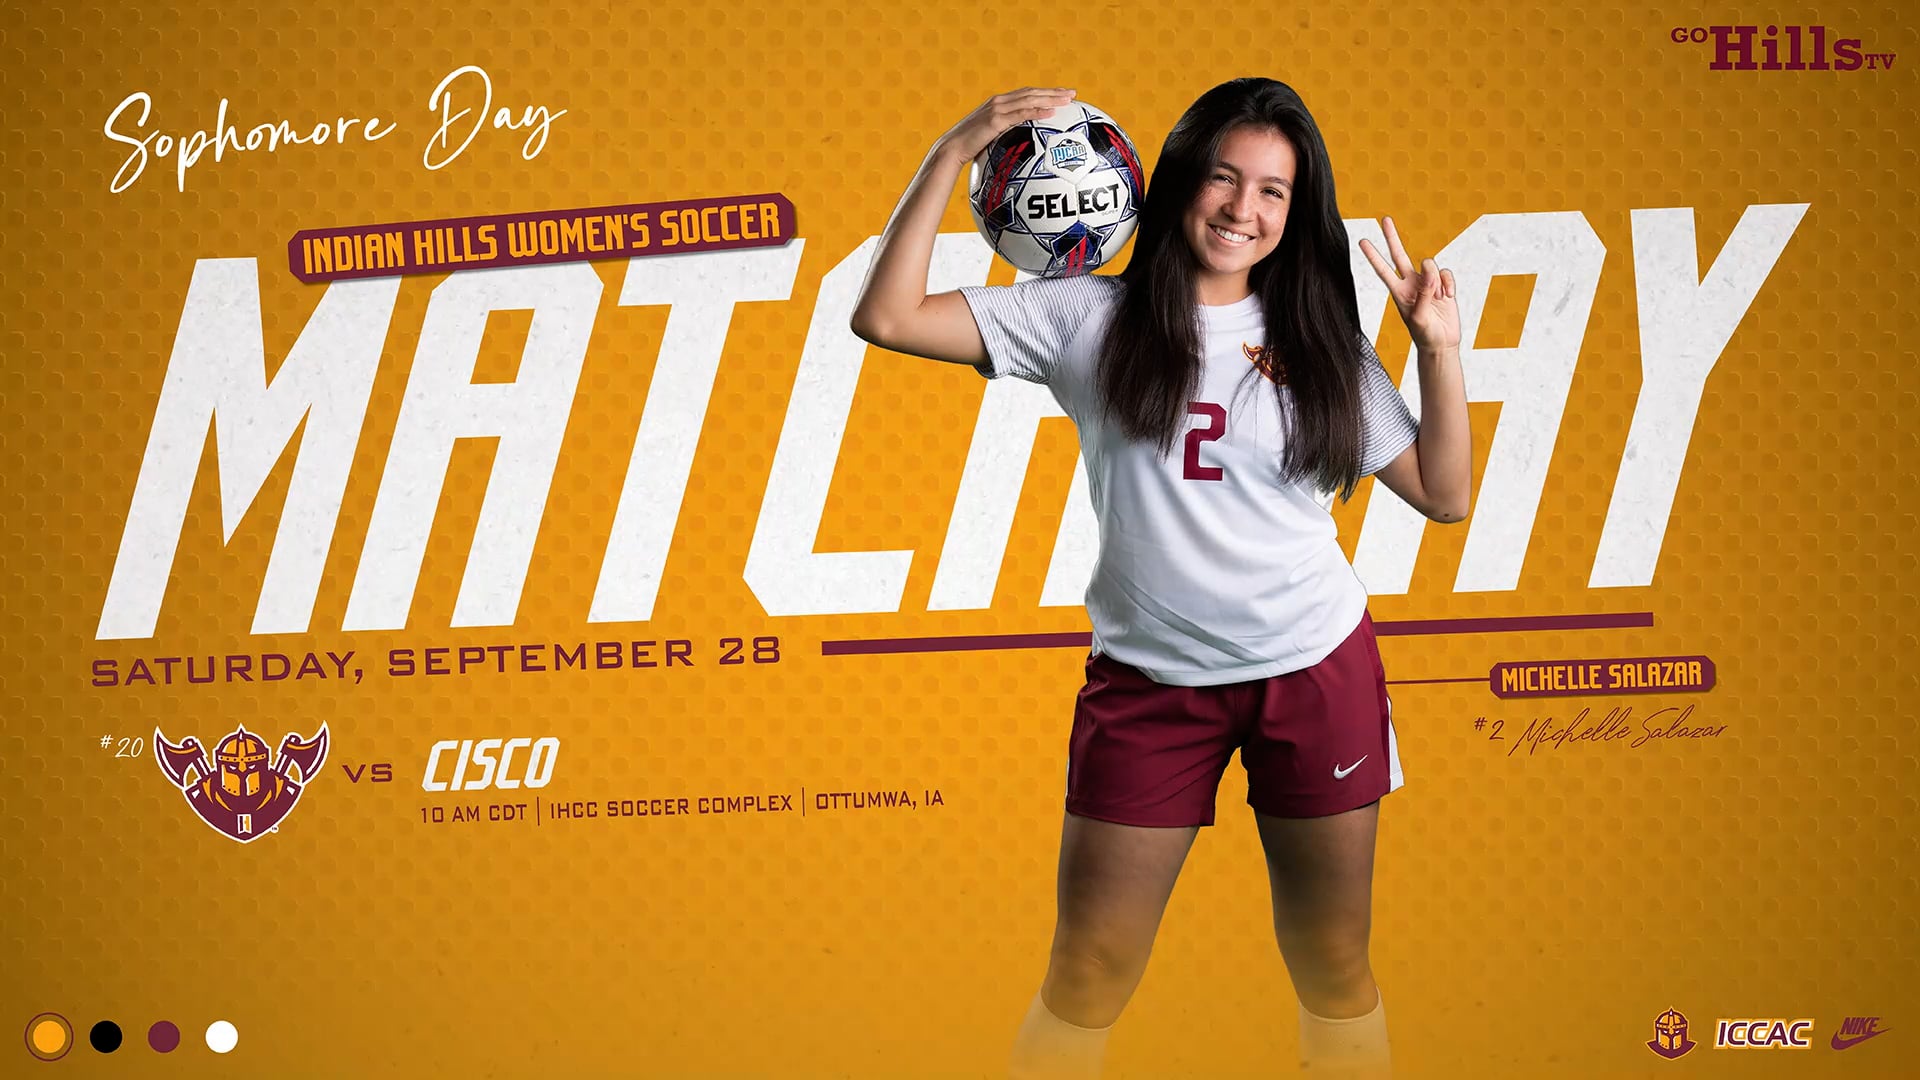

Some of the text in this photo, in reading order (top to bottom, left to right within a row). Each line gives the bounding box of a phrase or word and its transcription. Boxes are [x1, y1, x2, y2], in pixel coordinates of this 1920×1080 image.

[1670, 24, 1897, 71] GO Hills TV
[104, 65, 568, 194] Sophomore Day
[1027, 183, 1119, 219] SELECT
[302, 202, 781, 275] INDIAN HILLS WOMEN'S SOCCER
[1183, 401, 1227, 481] 2
[91, 636, 780, 688] SATURDAY, SEPTEMBER 28
[1501, 661, 1702, 692] MICHELLE SALAZAR
[1507, 706, 1633, 757] Michelle
[1630, 703, 1729, 749] Salazar
[342, 763, 393, 784] VS
[421, 737, 561, 792] CISCO
[420, 789, 945, 824] 10 AM CDT IHCC SOCCER COMPLEX OTTUMWA, IA
[1717, 1021, 1811, 1046] ICCAC
[1840, 1016, 1880, 1036] NIKE
